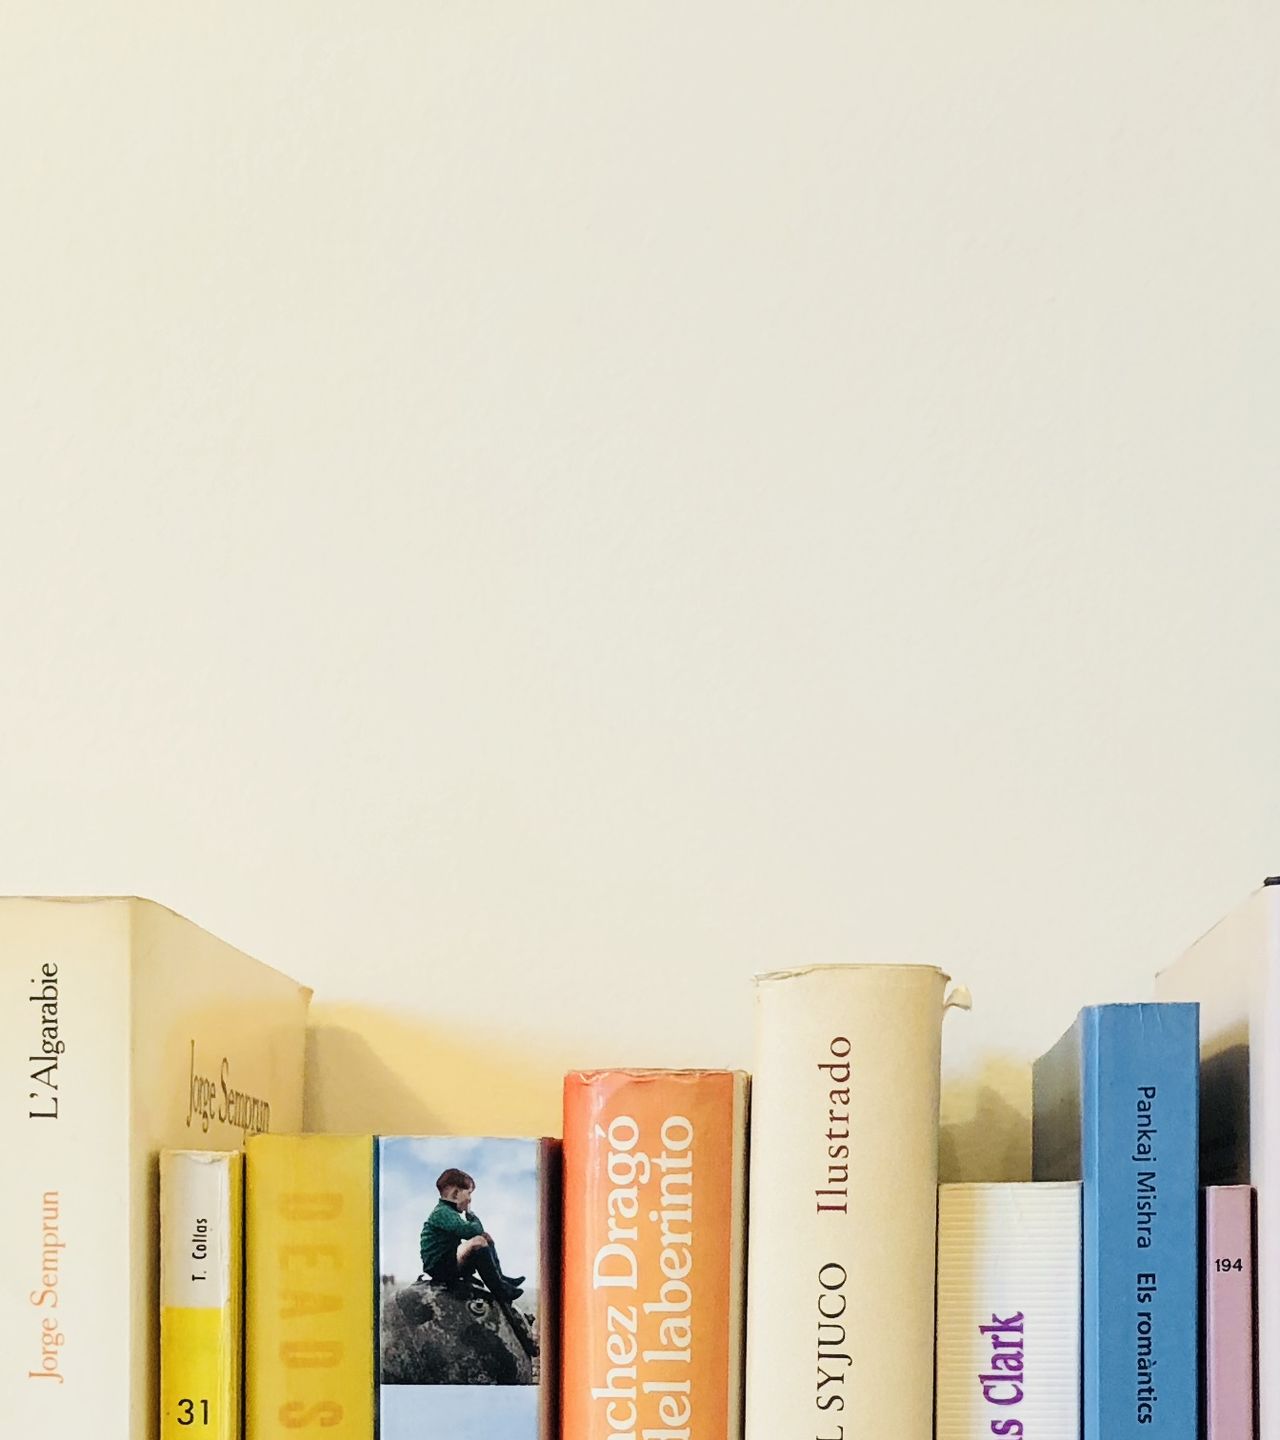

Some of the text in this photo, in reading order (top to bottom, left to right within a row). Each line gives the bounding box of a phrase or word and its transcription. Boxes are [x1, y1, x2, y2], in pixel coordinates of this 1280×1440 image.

[29, 962, 65, 1119] L'Algarabie
[186, 1040, 216, 1133] Jorge
[593, 1114, 651, 1290] Dragó
[815, 1035, 851, 1215] Ilustrado
[29, 1190, 65, 1384] Jorge Semprun
[278, 1192, 344, 1368] DEAD
[643, 1115, 694, 1366] laberinto
[1132, 1086, 1158, 1424] Pankaj Mishra Els romàntics
[1214, 1259, 1243, 1272] 194
[177, 1400, 209, 1425] 31
[815, 1262, 852, 1412] SYJUCO
[979, 1311, 1024, 1406] Clark
